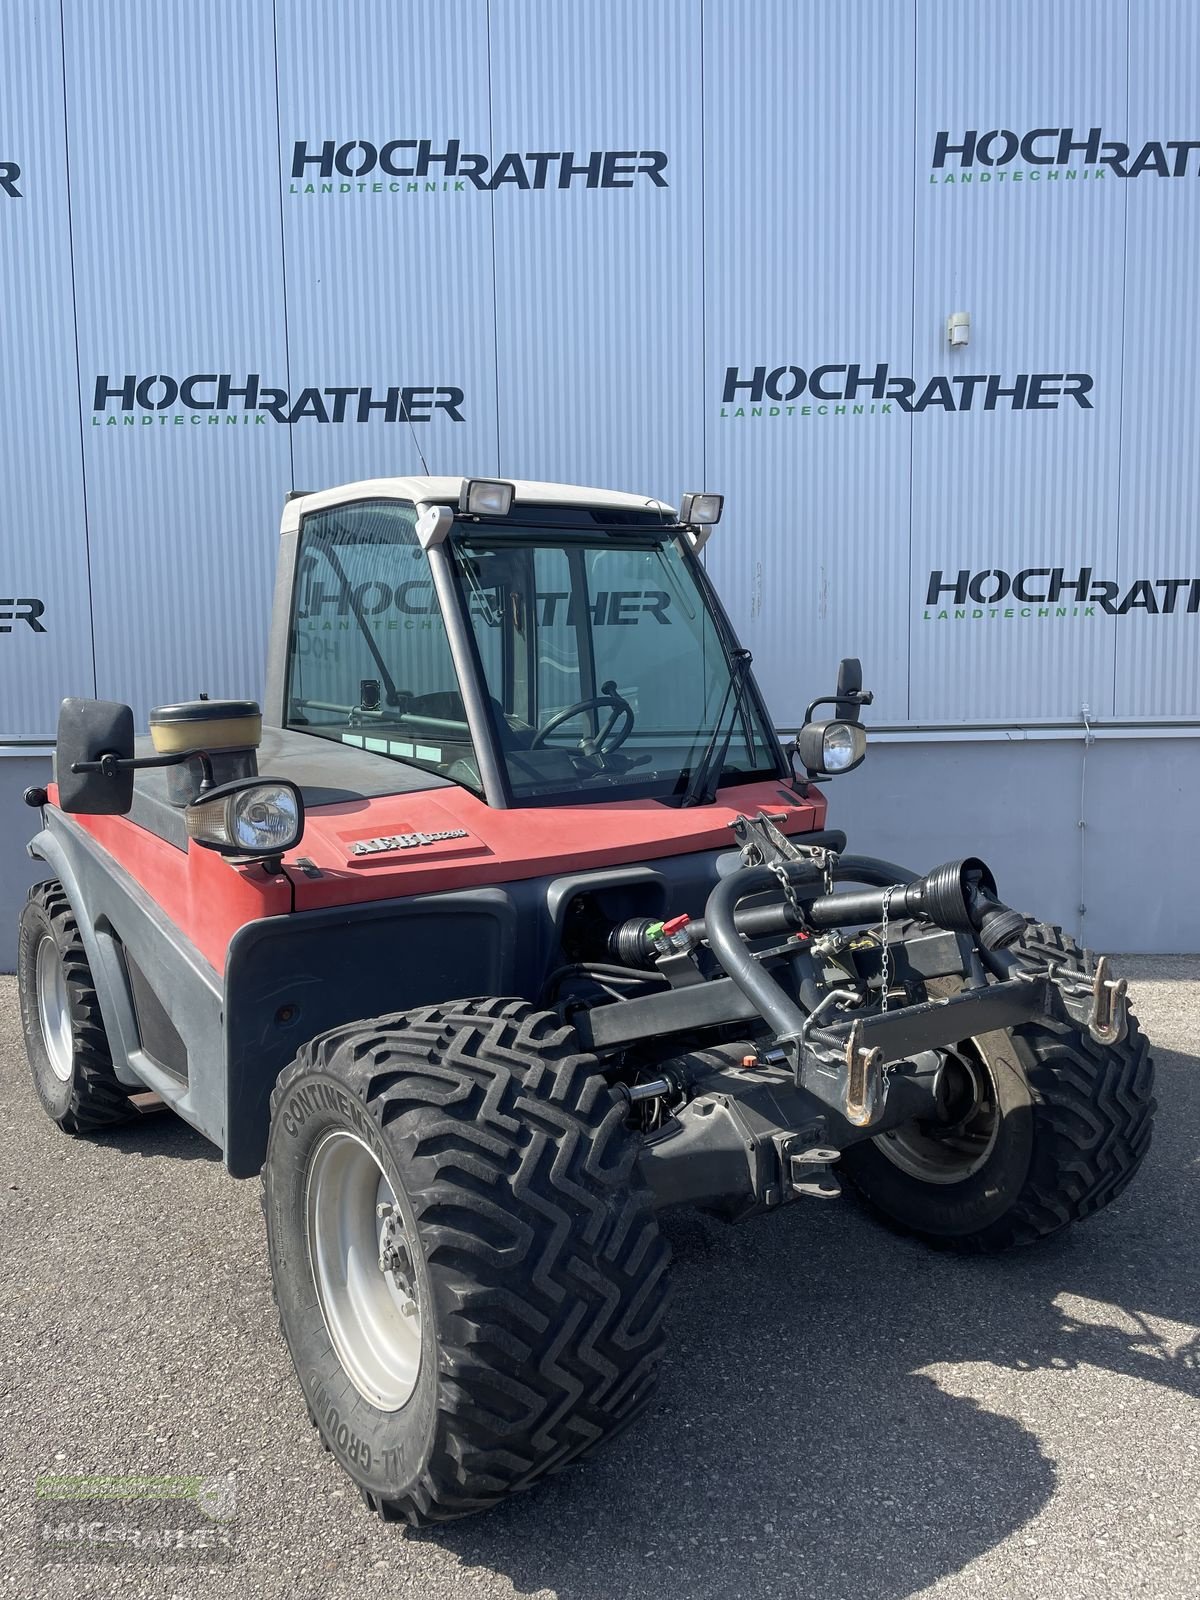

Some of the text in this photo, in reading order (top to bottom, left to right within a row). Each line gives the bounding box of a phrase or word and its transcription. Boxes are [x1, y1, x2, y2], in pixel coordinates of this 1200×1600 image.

[931, 127, 1200, 179] HOCHRAT
[291, 138, 670, 192] HOCHRATHER
[929, 168, 1107, 185] LANDTECHNIK
[290, 180, 467, 194] LANDTECHNIK
[722, 362, 1095, 414] HOCHRATHER
[93, 373, 466, 425] HOCHRATHER
[720, 403, 893, 418] LANDTECHNIK
[92, 413, 268, 427] LANDTECHNIK
[923, 606, 1096, 620] LANDTECHNIK
